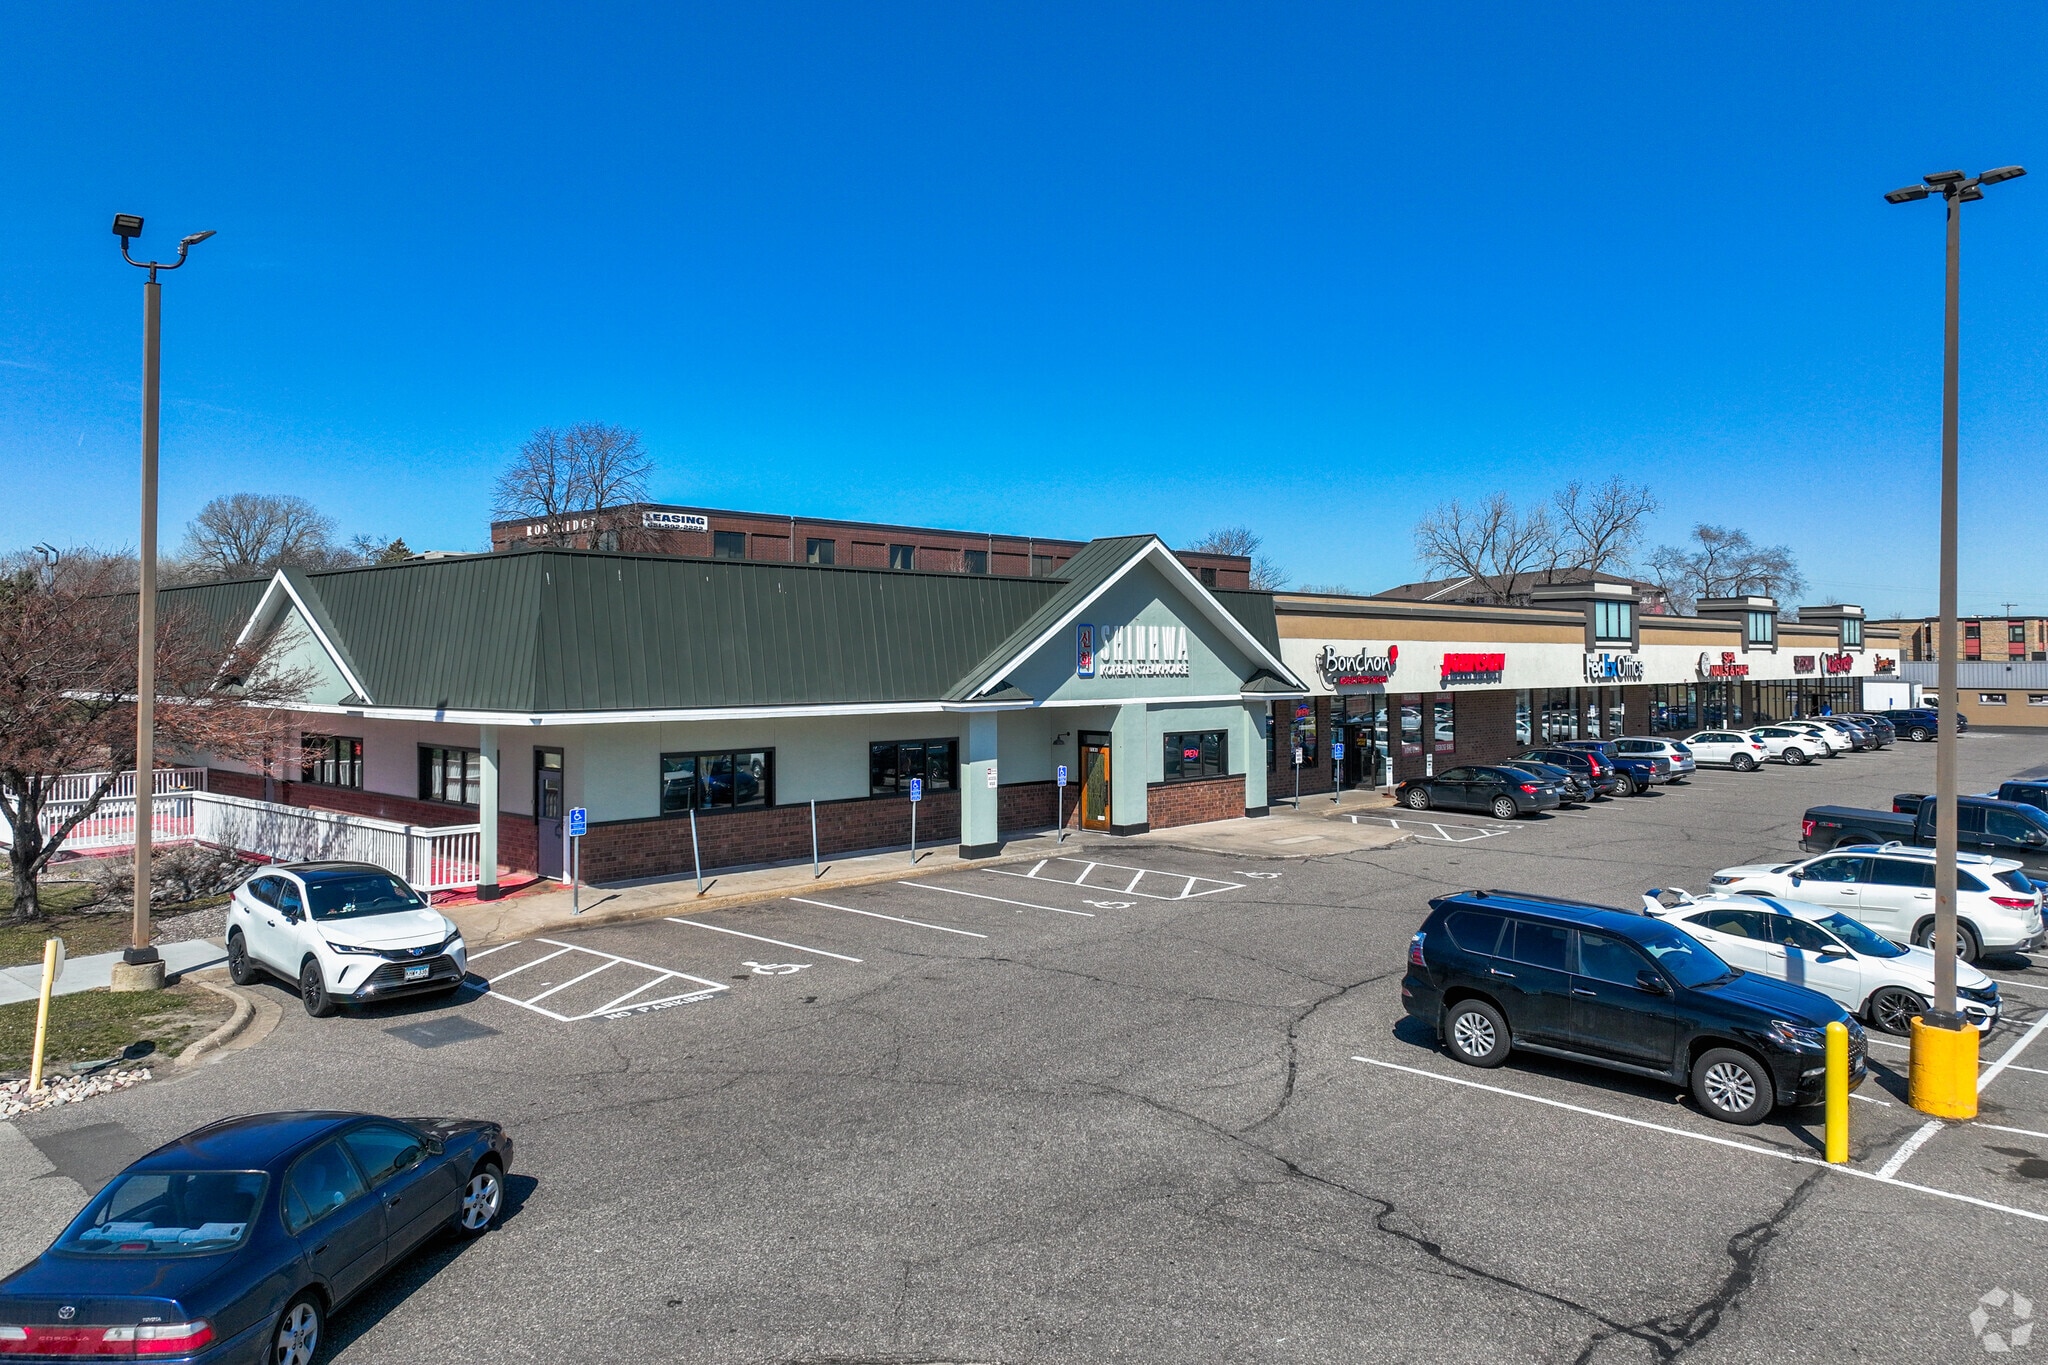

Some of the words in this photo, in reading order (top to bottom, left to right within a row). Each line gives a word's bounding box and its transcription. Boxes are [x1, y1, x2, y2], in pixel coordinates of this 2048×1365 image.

[645, 513, 705, 525] LEASING
[1100, 625, 1188, 661] SHINHWA
[1324, 645, 1391, 671] Bonchon
[1100, 664, 1135, 675] KOREAN
[1136, 664, 1189, 675] STEAKHOUSE
[1585, 653, 1618, 678] FedEx
[1617, 655, 1645, 677] Office
[1711, 665, 1729, 676] NAILS
[1184, 749, 1198, 758] PEN
